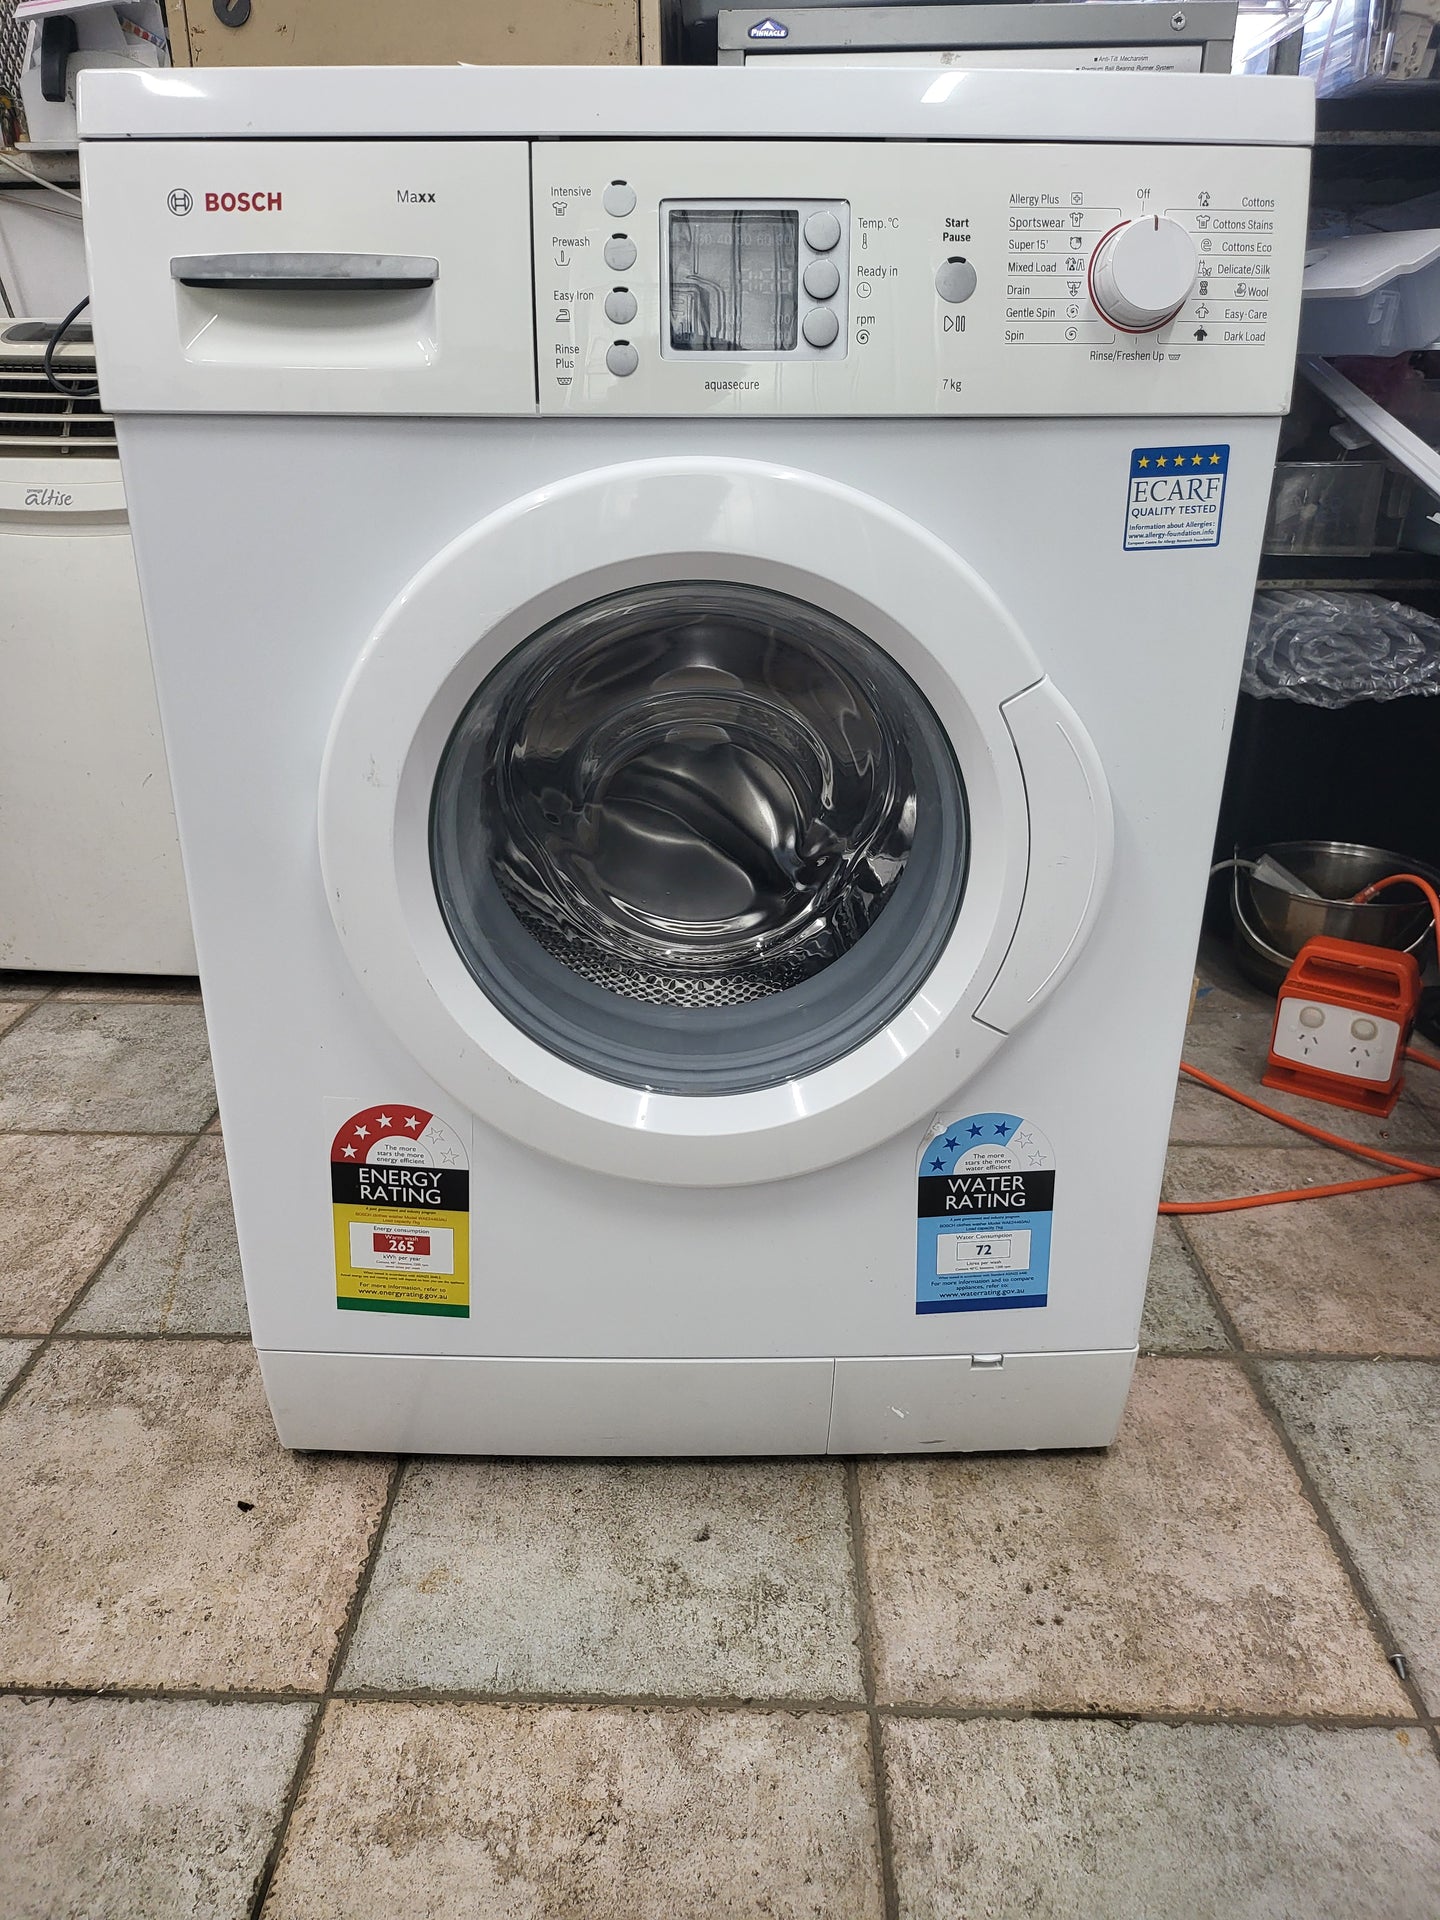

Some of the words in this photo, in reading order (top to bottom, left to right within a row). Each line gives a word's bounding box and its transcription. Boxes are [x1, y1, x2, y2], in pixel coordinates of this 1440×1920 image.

[396, 190, 436, 203] Maxx
[551, 186, 592, 197] Intensive
[1137, 188, 1151, 199] Off
[205, 191, 282, 212] BOSCH
[1009, 194, 1039, 206] Allergy
[1041, 194, 1060, 204] Plus
[1242, 197, 1274, 208] Cottons
[858, 218, 887, 231] Temp.
[888, 217, 899, 229] °C
[945, 218, 969, 228] Start
[1009, 217, 1065, 229] Sportswear
[1213, 220, 1246, 230] Cottons
[1248, 220, 1273, 230] Stains
[552, 236, 590, 248] Prewash
[943, 232, 971, 242] Pause
[1008, 240, 1035, 251] Super
[1036, 240, 1049, 249] 15'
[1222, 242, 1255, 252] Cottons
[1257, 243, 1272, 252] Eco
[857, 266, 887, 279] Ready
[889, 266, 898, 276] in
[1008, 262, 1033, 272] Mixed
[1036, 262, 1056, 272] Load
[1217, 264, 1270, 275] Delicate/Silk
[1007, 285, 1030, 295] Drain
[1248, 287, 1268, 297] Wool
[554, 290, 574, 302] Easy
[576, 290, 594, 301] Iron
[1006, 307, 1034, 318] Gentle
[1036, 307, 1056, 319] Spin
[856, 316, 876, 326] rpm
[1005, 331, 1024, 342] Spin
[1224, 331, 1243, 341] Dark
[1245, 331, 1265, 341] Load
[555, 344, 580, 354] Rinse
[1090, 350, 1150, 362] Rinse/Freshen
[1152, 351, 1164, 362] Up
[556, 358, 575, 369] Plus
[704, 380, 760, 392] aquasecure
[943, 379, 949, 390] 7
[950, 379, 962, 392] kg
[1132, 477, 1220, 503] ECARF
[25, 488, 73, 506] altise
[1132, 507, 1176, 518] QUALITY
[1179, 504, 1217, 514] TESTED
[1185, 520, 1215, 528] Allergies:
[1128, 529, 1214, 539] www.allergy-foundation.info
[359, 1168, 442, 1188] ENERGY
[948, 1176, 1025, 1193] WATER
[360, 1184, 441, 1204] RATING
[946, 1192, 1026, 1210] RATING
[389, 1240, 415, 1252] 265
[975, 1244, 992, 1256] 72
[358, 1289, 448, 1300] www.energyrating.gov.au
[940, 1288, 1025, 1298] www.waterrating.gov.au
